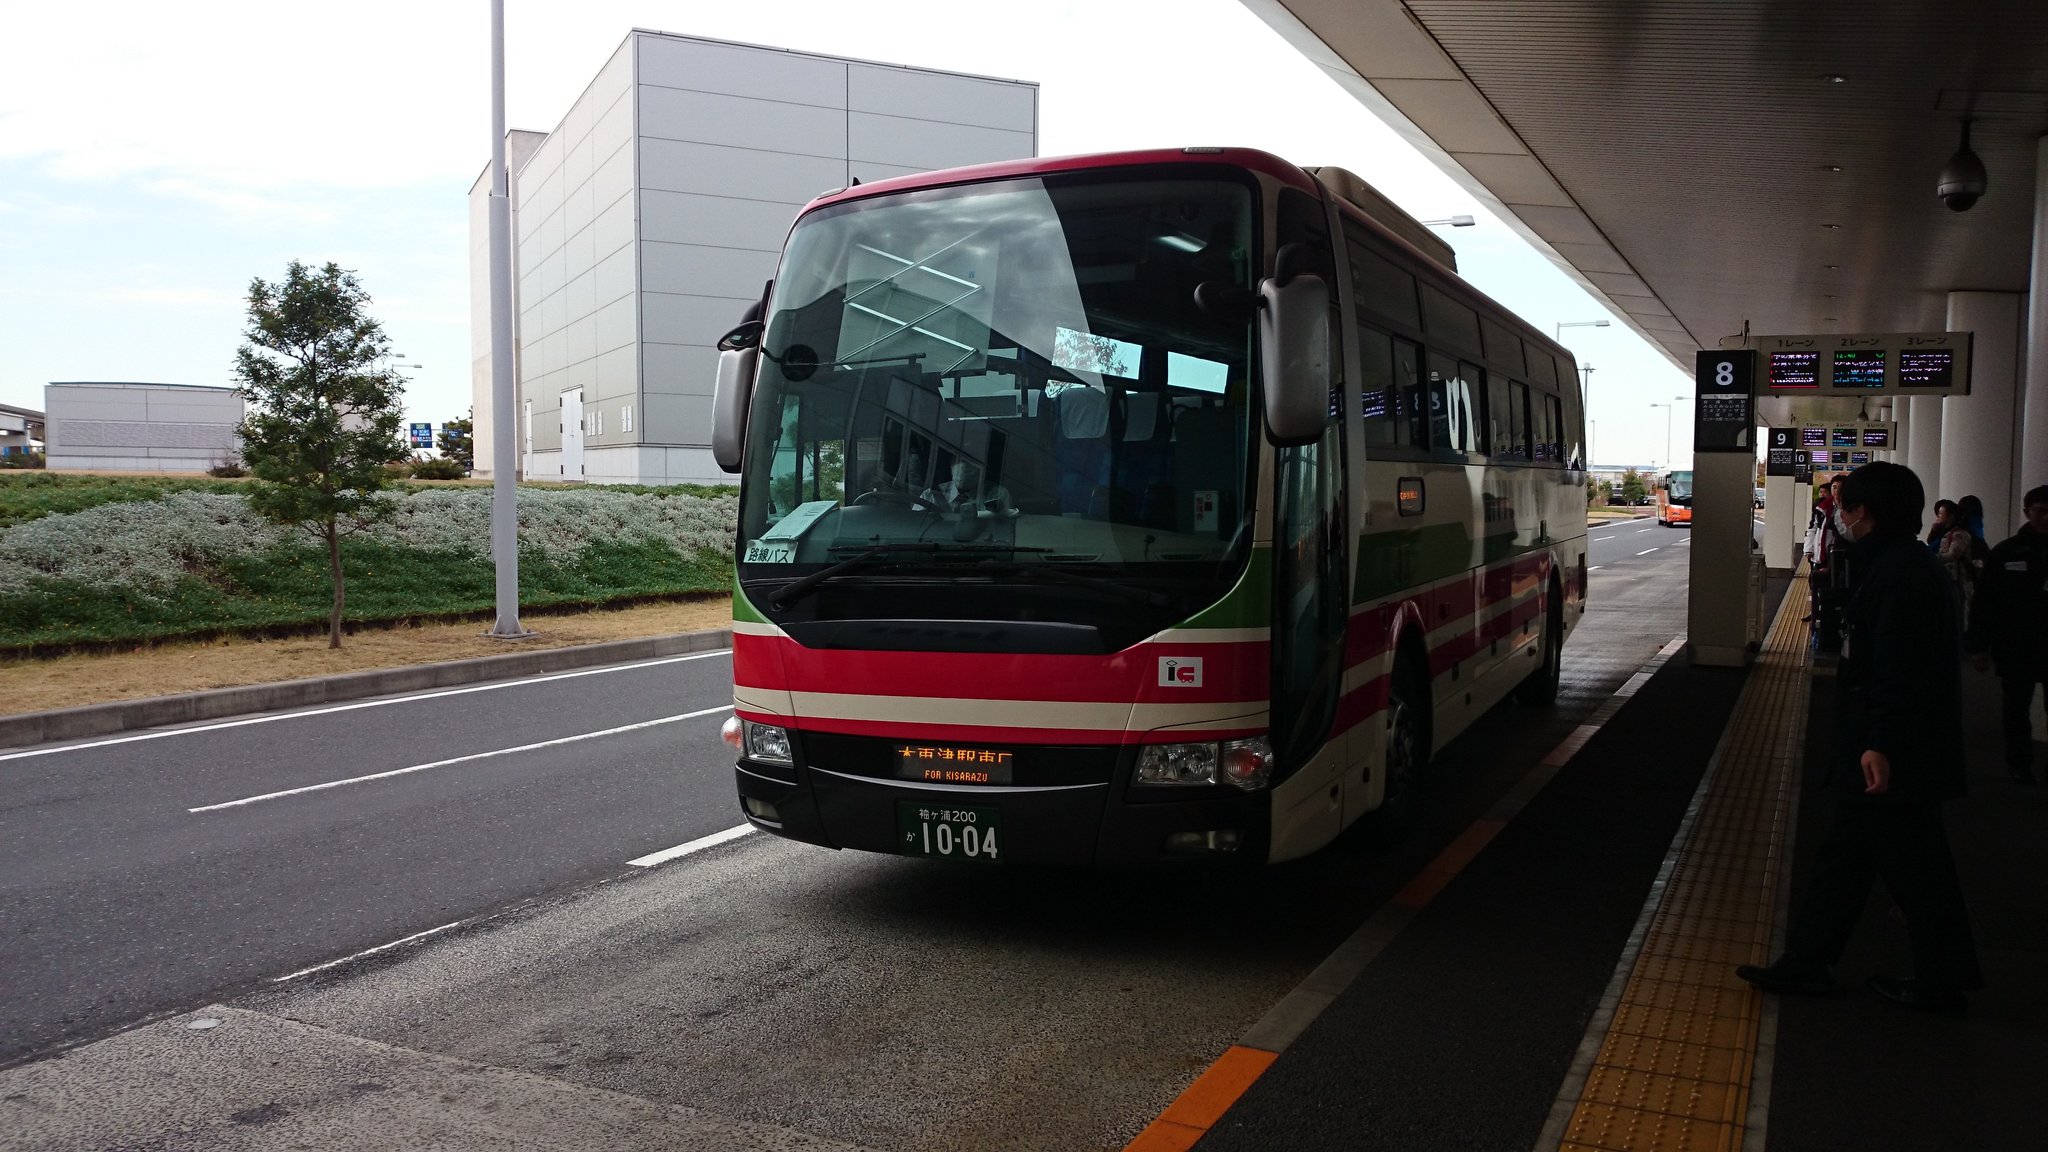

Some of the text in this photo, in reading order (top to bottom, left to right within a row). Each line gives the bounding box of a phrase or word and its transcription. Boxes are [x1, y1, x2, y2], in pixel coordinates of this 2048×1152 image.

[1778, 339, 1815, 348] 1レーン
[1841, 338, 1880, 347] 2レーン
[1906, 336, 1948, 346] 3レーン
[1715, 361, 1734, 386] 8
[1777, 433, 1786, 445] 9
[747, 547, 789, 563] 路線バス
[924, 769, 988, 782] FOR KISARAZU
[906, 822, 998, 859] か 10-04
